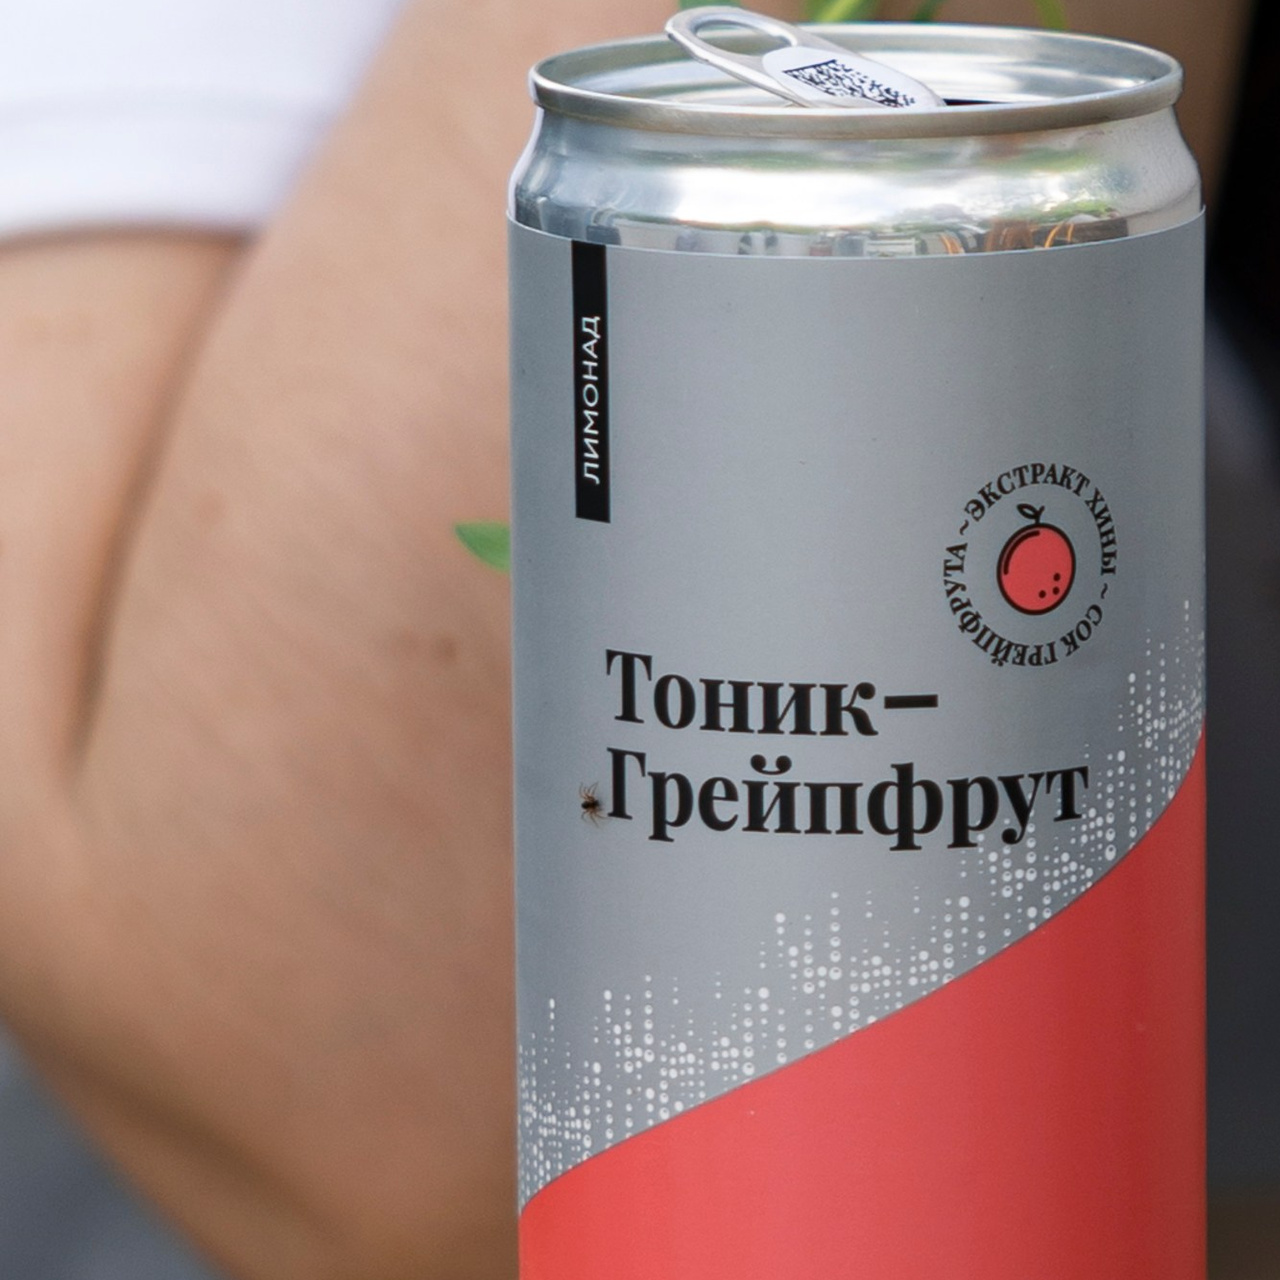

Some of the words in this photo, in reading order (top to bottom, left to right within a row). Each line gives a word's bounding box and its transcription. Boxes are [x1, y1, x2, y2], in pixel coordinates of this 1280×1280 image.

[581, 314, 601, 485] ЛИМОНАД
[963, 462, 1091, 522] ЭКСТРАКТ
[1084, 487, 1118, 577] ХИНЫ
[943, 541, 1059, 667] ГРЕЙПФРУТА
[1059, 603, 1104, 657] СОК
[605, 746, 1090, 852] Грейпфрут
